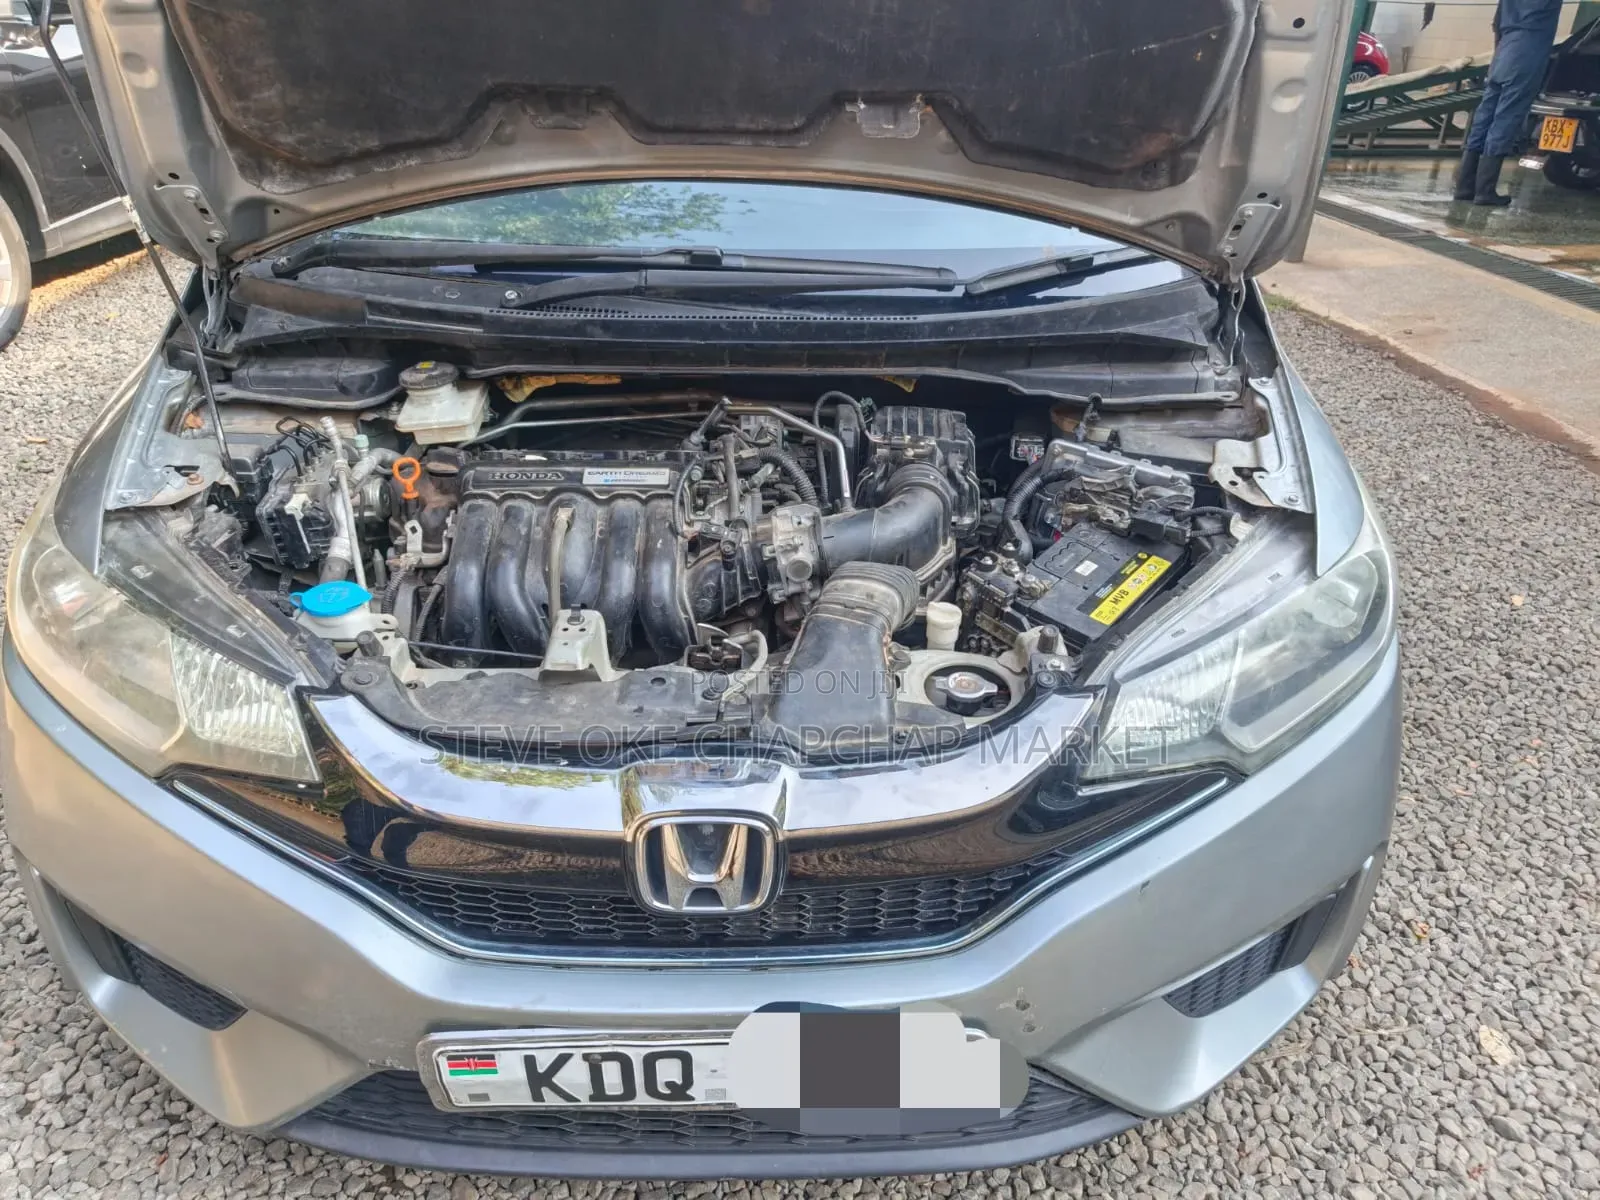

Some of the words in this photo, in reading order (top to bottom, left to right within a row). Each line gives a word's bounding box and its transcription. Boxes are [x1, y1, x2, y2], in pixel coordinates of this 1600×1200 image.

[1544, 119, 1567, 134] KBX
[1543, 133, 1571, 149] 977J
[488, 471, 564, 482] HONDA
[523, 1050, 696, 1102] KDQ
